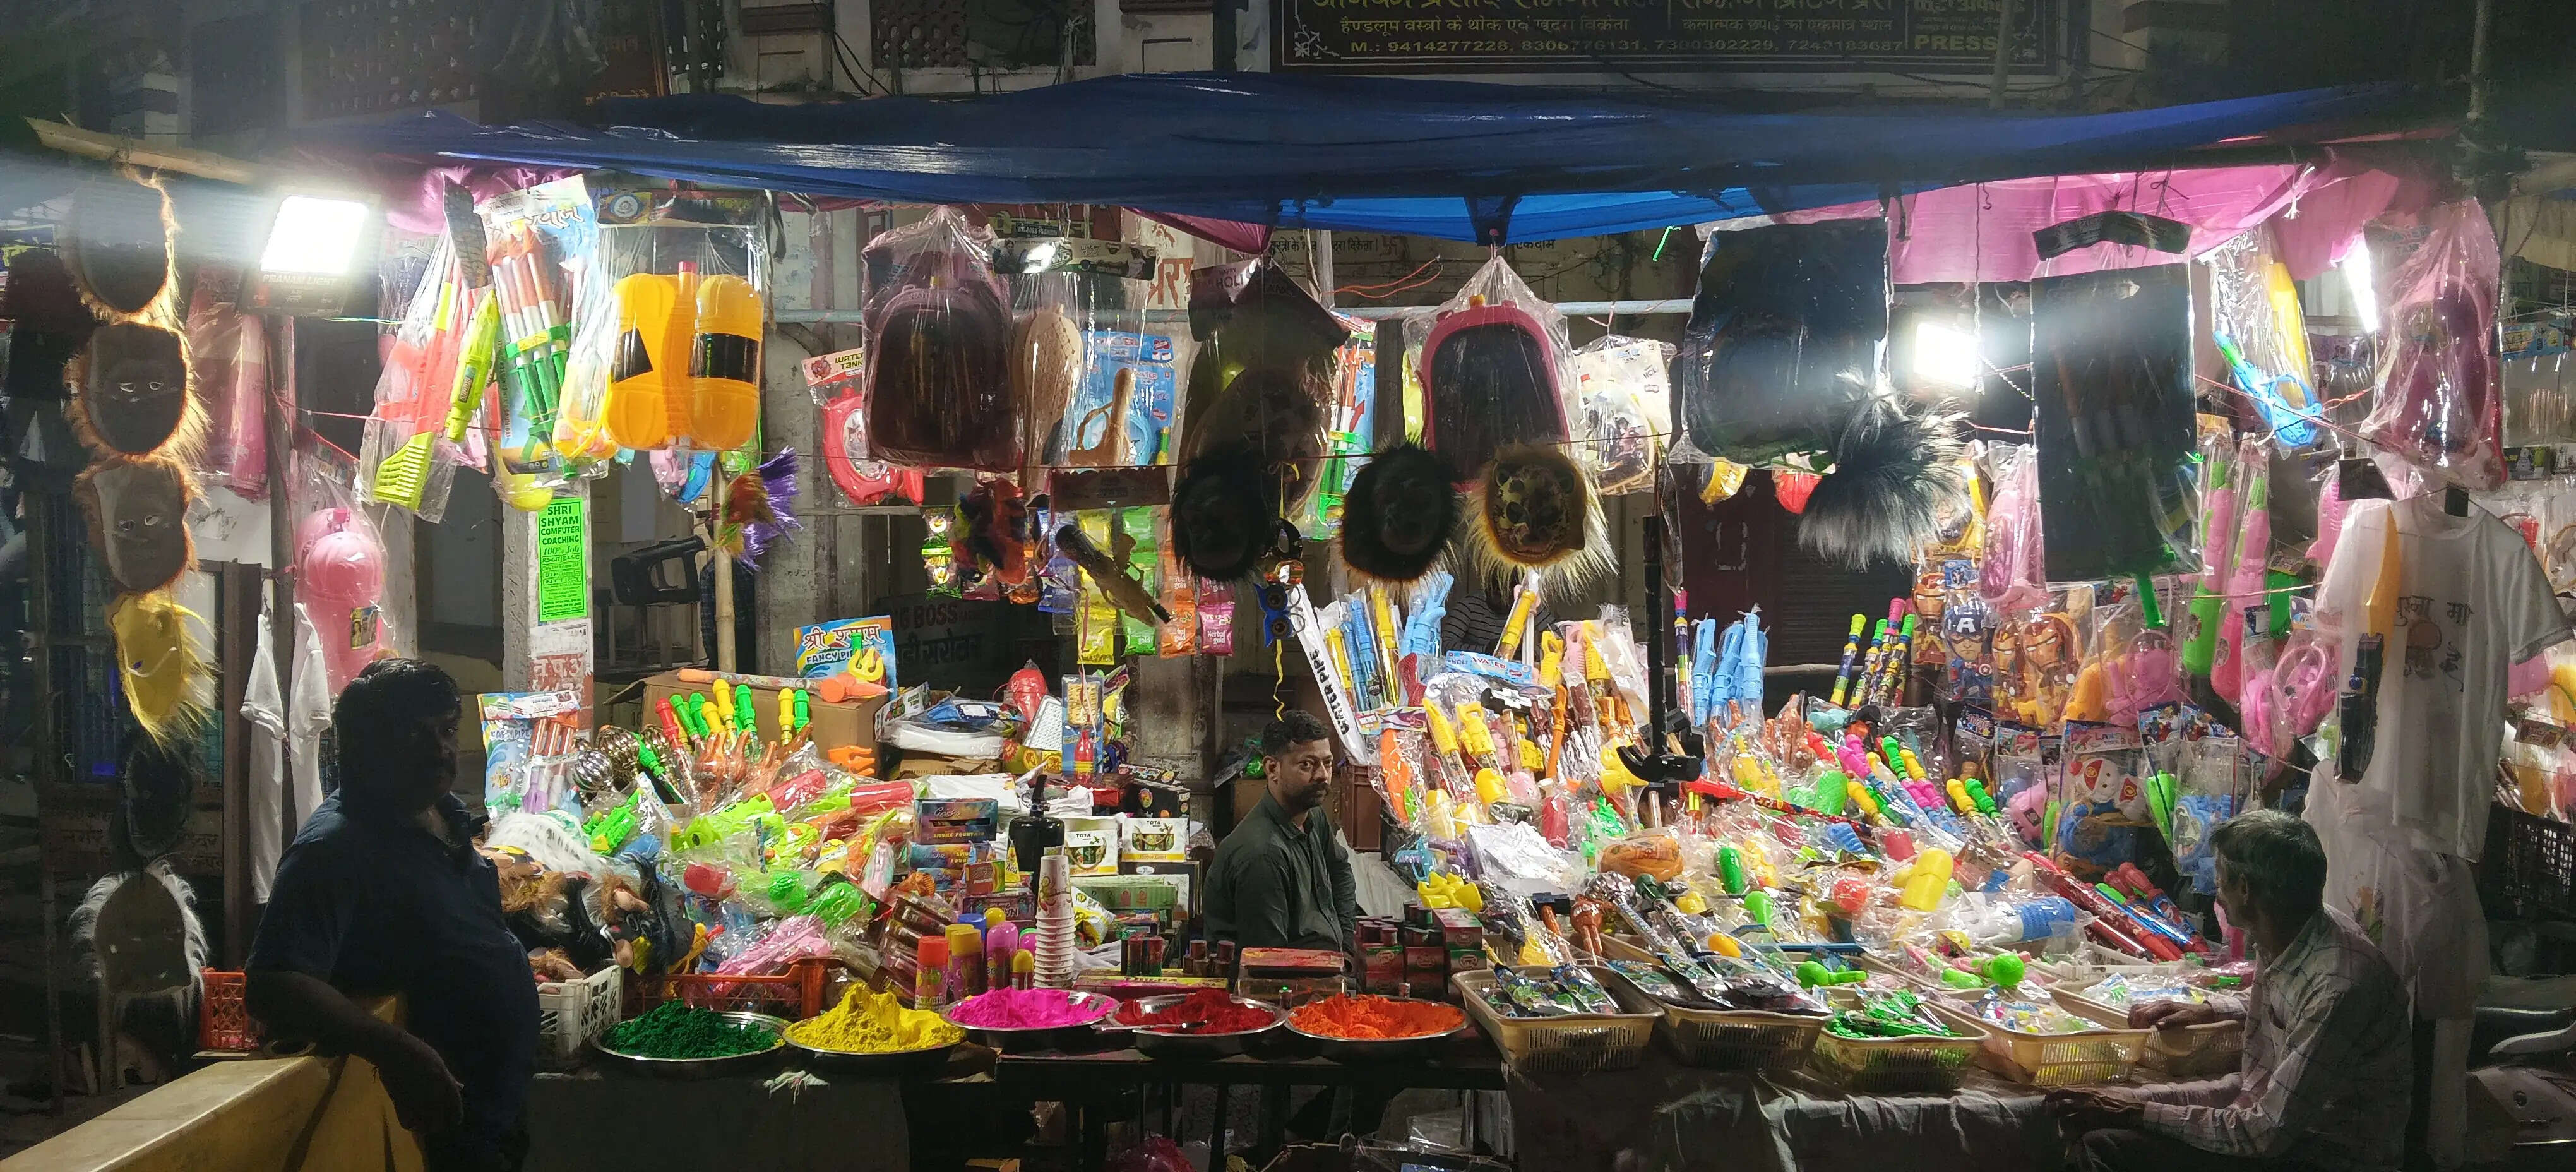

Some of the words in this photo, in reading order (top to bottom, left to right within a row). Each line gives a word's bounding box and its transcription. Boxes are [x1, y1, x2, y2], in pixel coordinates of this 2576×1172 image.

[1914, 35, 2000, 51] PRESS
[547, 505, 571, 516] SHRI
[540, 515, 578, 527] SHYAM
[540, 525, 580, 535] COMPUTER
[542, 535, 580, 545] COACHING
[806, 651, 838, 664] FANCY
[1309, 649, 1330, 684] PIPE
